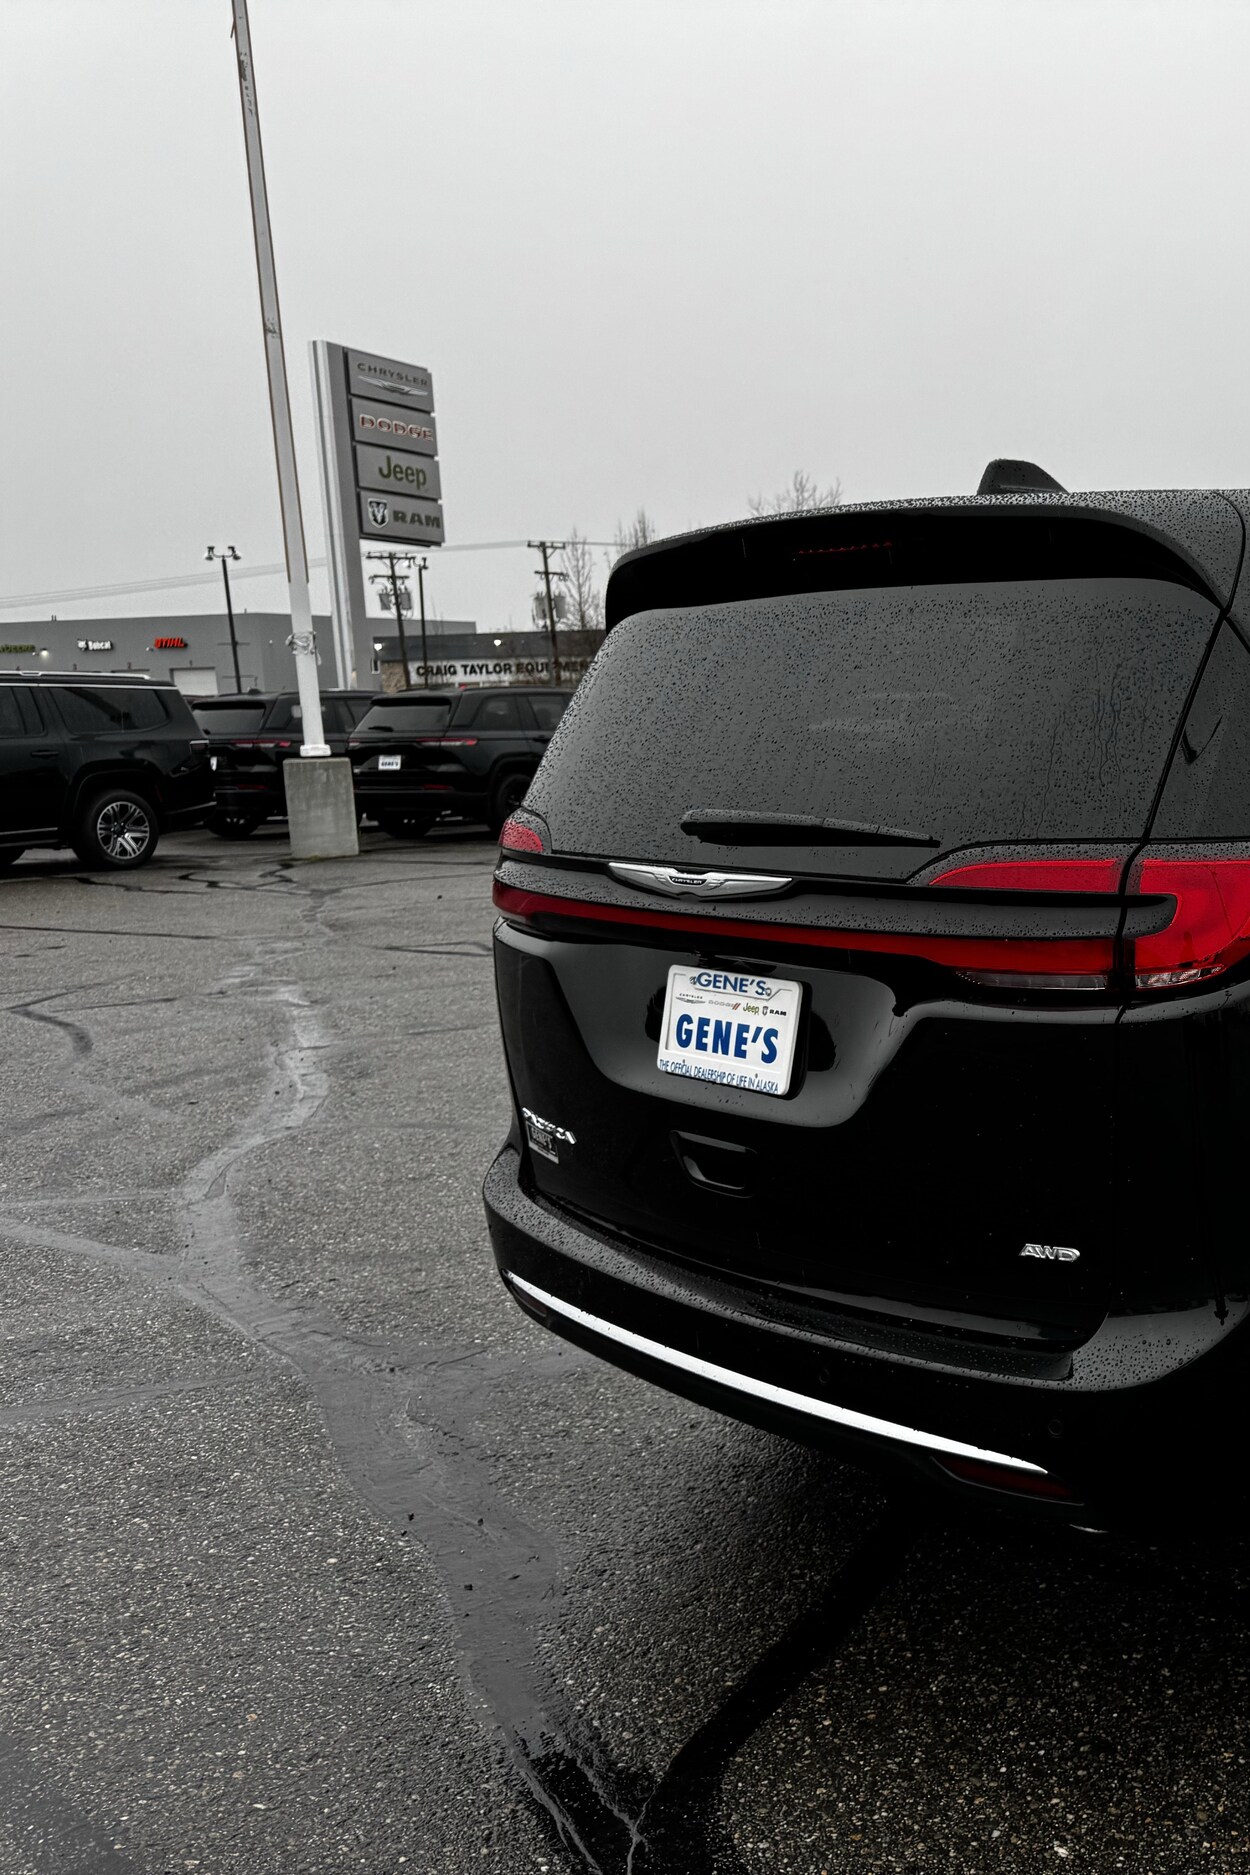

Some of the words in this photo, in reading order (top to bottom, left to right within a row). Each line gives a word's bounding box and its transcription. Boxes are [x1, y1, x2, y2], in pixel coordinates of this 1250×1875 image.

[357, 362, 428, 386] CHRYSLER
[359, 413, 434, 441] DODGE
[378, 455, 427, 491] Jeep
[393, 509, 441, 529] RAM
[88, 640, 112, 650] Bobcat
[154, 637, 185, 648] STIHL
[416, 664, 457, 676] CRAIG
[461, 662, 512, 675] TAYLOR
[696, 972, 766, 997] GENE'S
[743, 1003, 759, 1015] Jeep
[769, 1009, 787, 1017] RAM
[675, 1013, 779, 1064] GENE'S
[659, 1059, 669, 1070] THE
[670, 1061, 693, 1076] OFFICIAL
[693, 1066, 726, 1083] DEALERSHIP
[726, 1073, 736, 1084] OF
[736, 1074, 747, 1087] LIFE
[748, 1078, 755, 1088] IN
[756, 1079, 779, 1094] ALASKA
[1018, 1243, 1081, 1262] AWD
